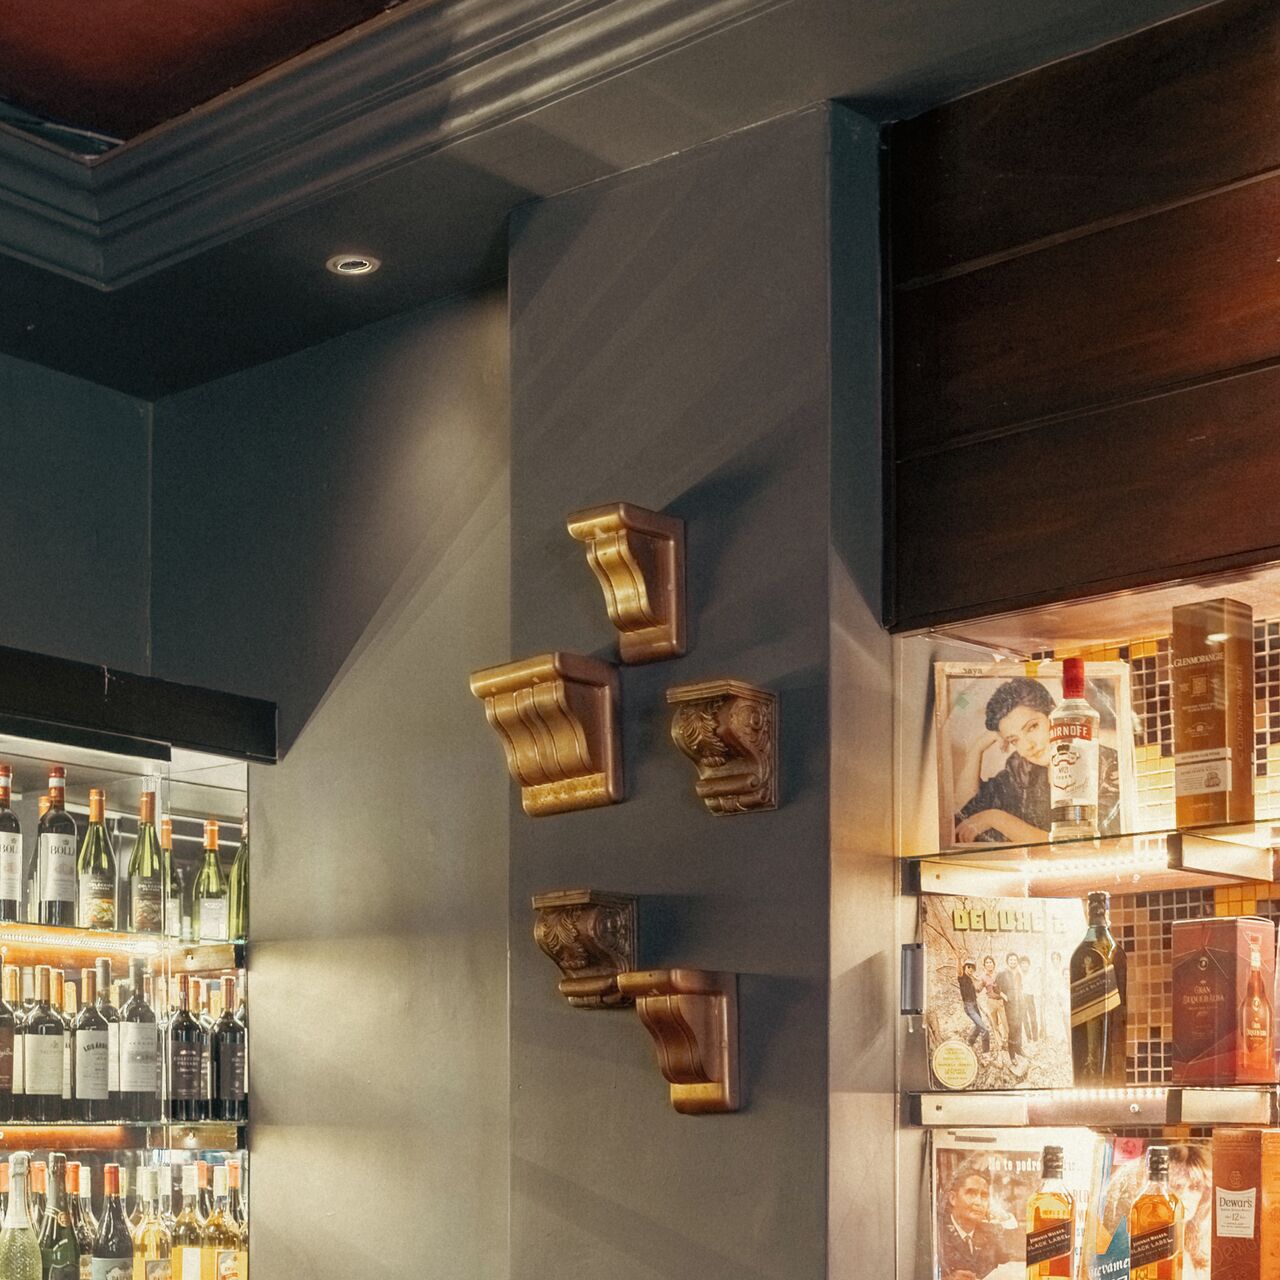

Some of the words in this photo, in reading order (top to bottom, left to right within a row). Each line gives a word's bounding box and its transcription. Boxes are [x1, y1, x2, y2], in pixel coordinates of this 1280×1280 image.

[1173, 652, 1224, 667] GLENMORANGIE
[1050, 725, 1089, 738] MIRNOFF
[1219, 1196, 1252, 1208] Dewar's
[1089, 1258, 1131, 1277] uevame
